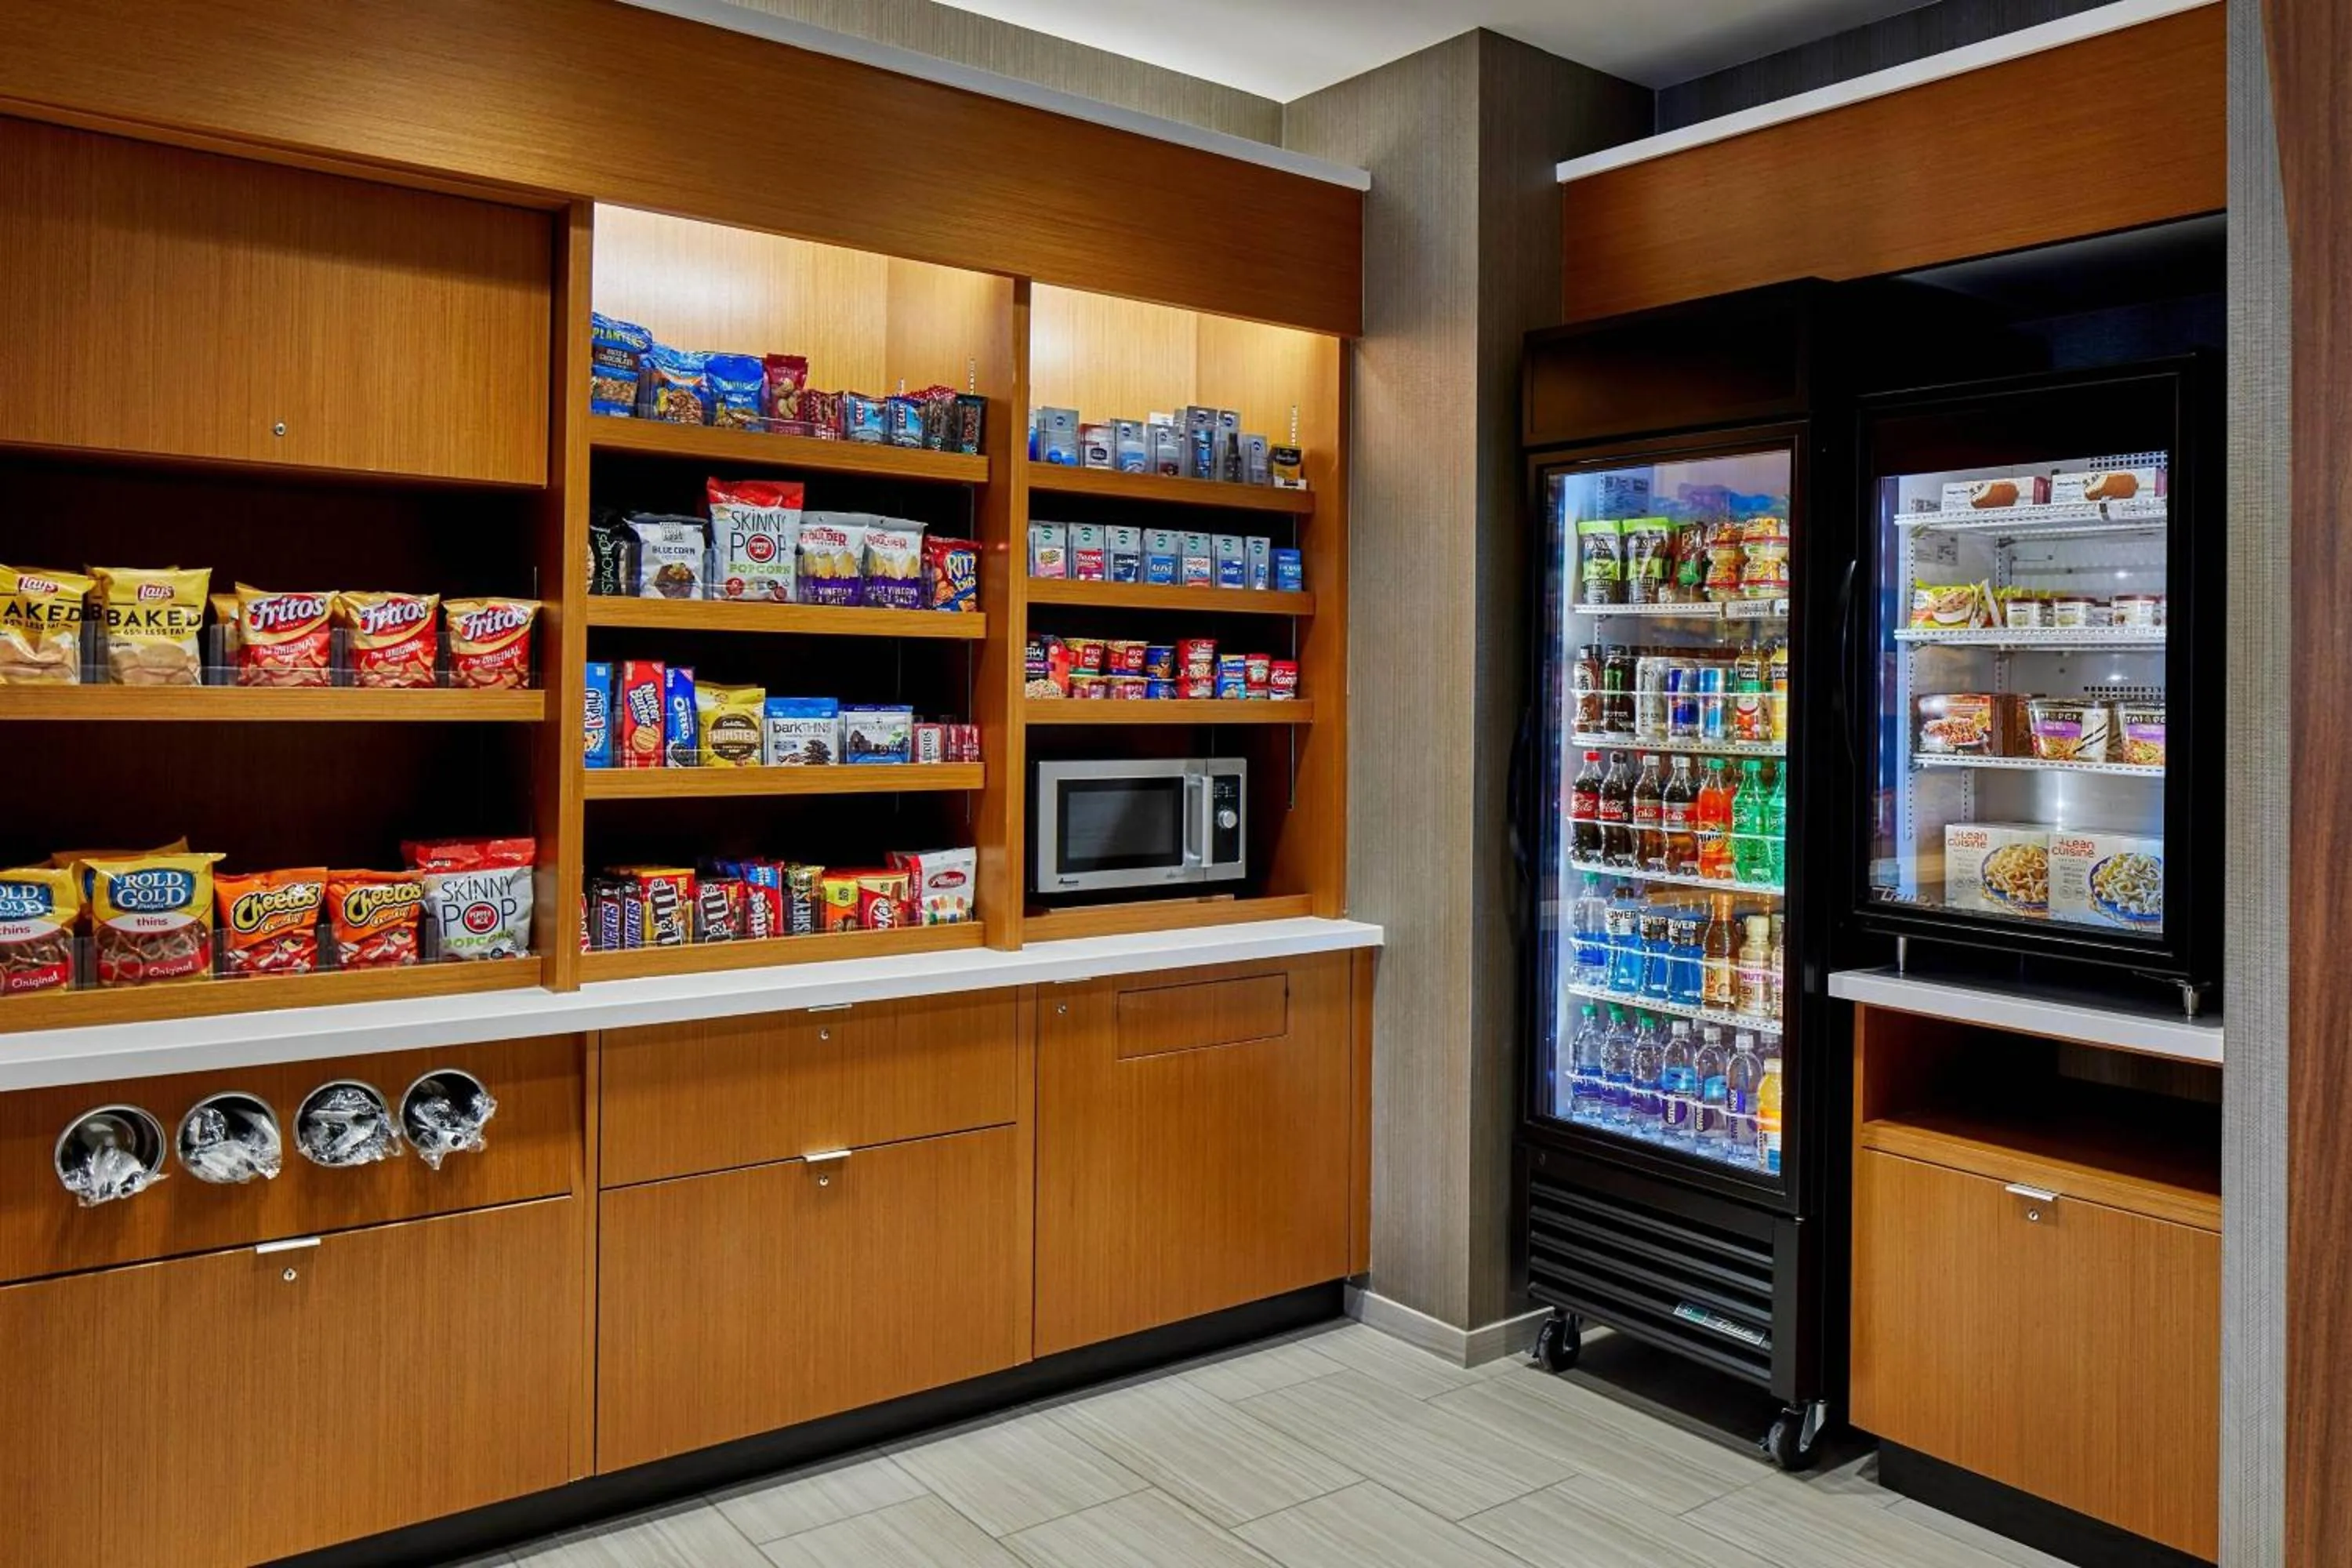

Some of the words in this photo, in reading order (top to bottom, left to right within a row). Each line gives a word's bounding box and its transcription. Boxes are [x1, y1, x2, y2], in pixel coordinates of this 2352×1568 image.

[597, 533, 613, 593] STACHIOS
[652, 545, 673, 554] BLUE
[674, 546, 695, 555] CORN
[728, 564, 790, 574] POPCORN
[946, 553, 976, 582] RITZ
[3, 600, 81, 622] AKED
[106, 609, 201, 627] BAKED
[246, 597, 326, 632] Fritos
[358, 601, 427, 634] Fritos
[459, 604, 528, 641] Fritos
[630, 689, 652, 727] Butter
[641, 682, 661, 723] Nutter
[673, 696, 690, 739] OREO
[1947, 838, 1987, 849] Cuisine
[1962, 830, 1987, 840] Lean
[2066, 840, 2095, 850] Lean
[2052, 847, 2095, 858] Cuisine
[116, 887, 187, 908] GOLD
[441, 876, 515, 902] SKINNY
[0, 900, 45, 915] OLD
[234, 884, 319, 930] Cheetos
[346, 884, 421, 927] Cheetos
[441, 898, 517, 937] POP
[750, 891, 767, 939] ittles
[793, 892, 811, 934] SHEY'S
[136, 915, 169, 927] thins
[12, 972, 60, 989] Original
[148, 960, 194, 977] Original
